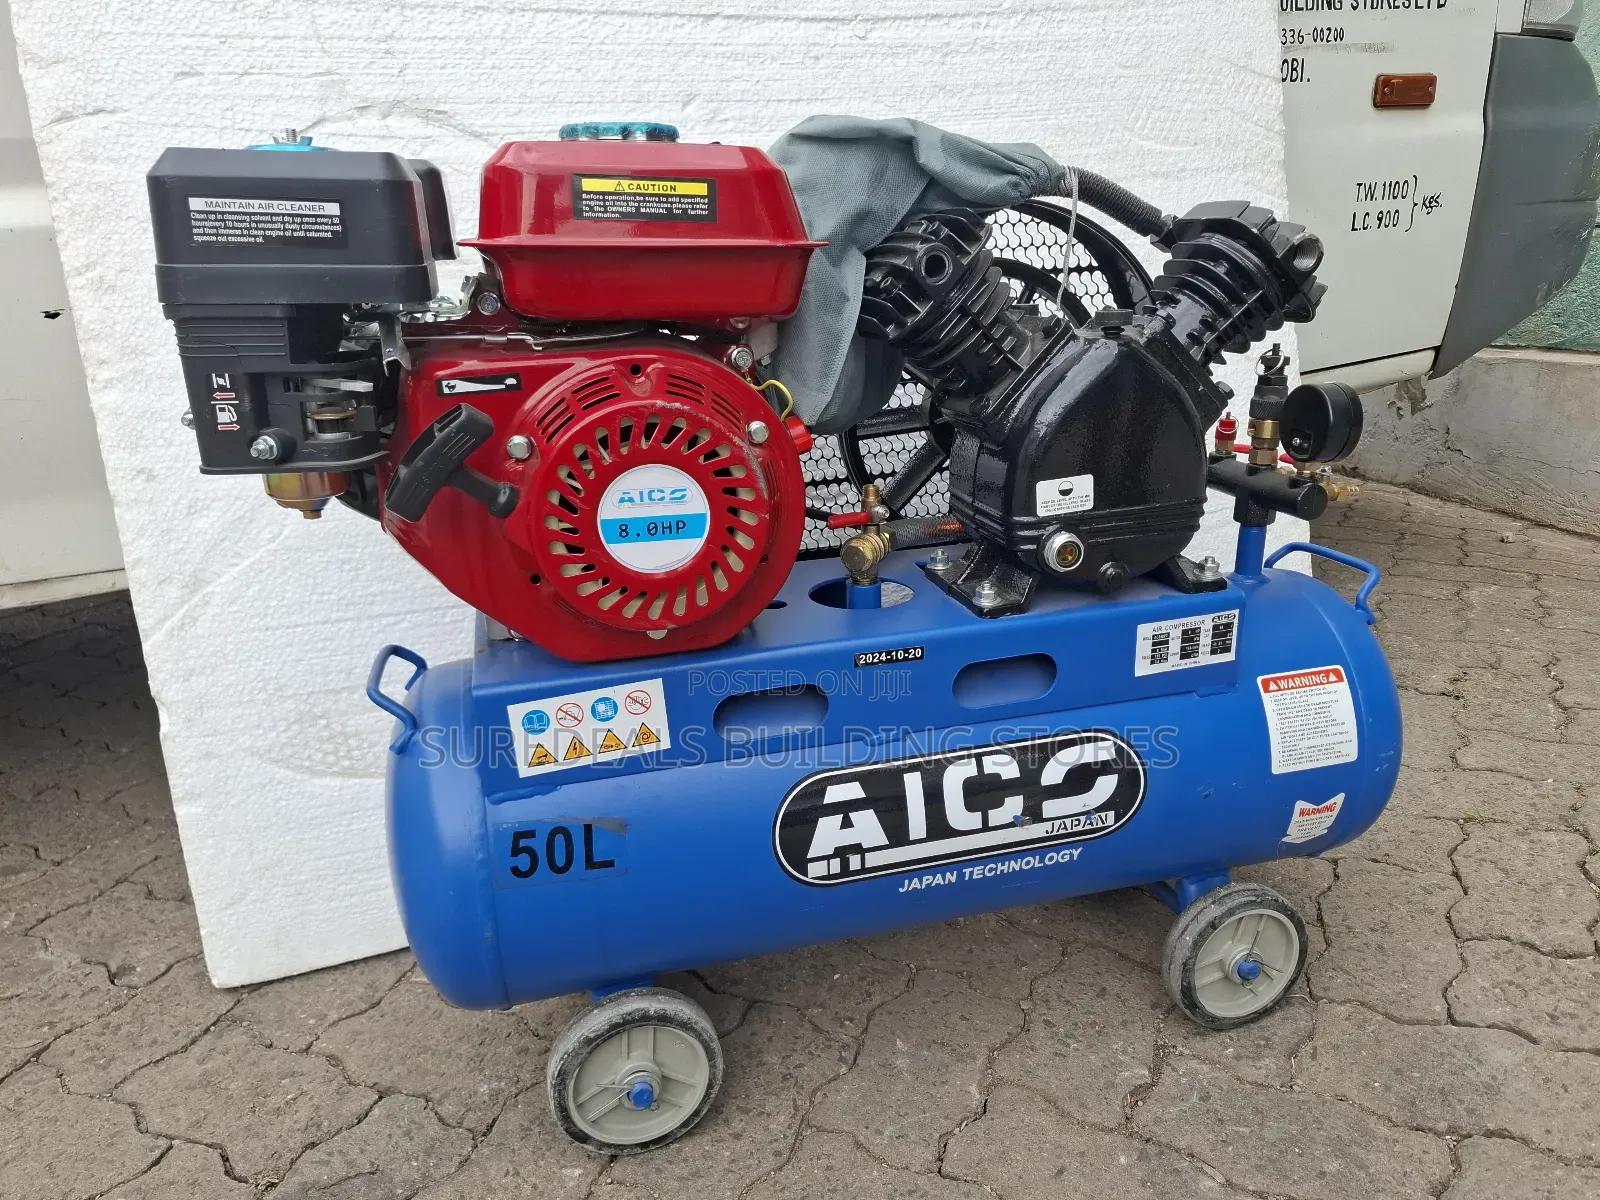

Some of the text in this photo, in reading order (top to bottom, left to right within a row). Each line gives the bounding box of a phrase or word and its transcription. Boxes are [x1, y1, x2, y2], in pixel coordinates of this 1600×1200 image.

[1281, 26, 1345, 45] 336-00200
[627, 183, 677, 193] CAUTION
[205, 200, 325, 213] MAINTAIN AIR CLEANER
[191, 212, 207, 220] Clean
[223, 213, 251, 222] cleansing
[283, 215, 293, 223] dry
[317, 217, 332, 225] every
[226, 220, 233, 228] 10
[257, 222, 284, 230] unusually
[284, 222, 300, 231] dusty
[193, 235, 217, 243] squeeze
[265, 230, 284, 238] engine
[618, 520, 687, 539] 8.0HP
[1152, 625, 1163, 633] AIR
[1164, 618, 1206, 632] COMPRESSOR
[859, 648, 923, 665] 2024-10-20
[1277, 673, 1328, 690] WARNING
[1299, 801, 1337, 818] WARNING
[1045, 812, 1109, 835] JAPAN
[509, 823, 616, 879] 50L
[898, 847, 1083, 893] JAPAN TECHNOLOGY
